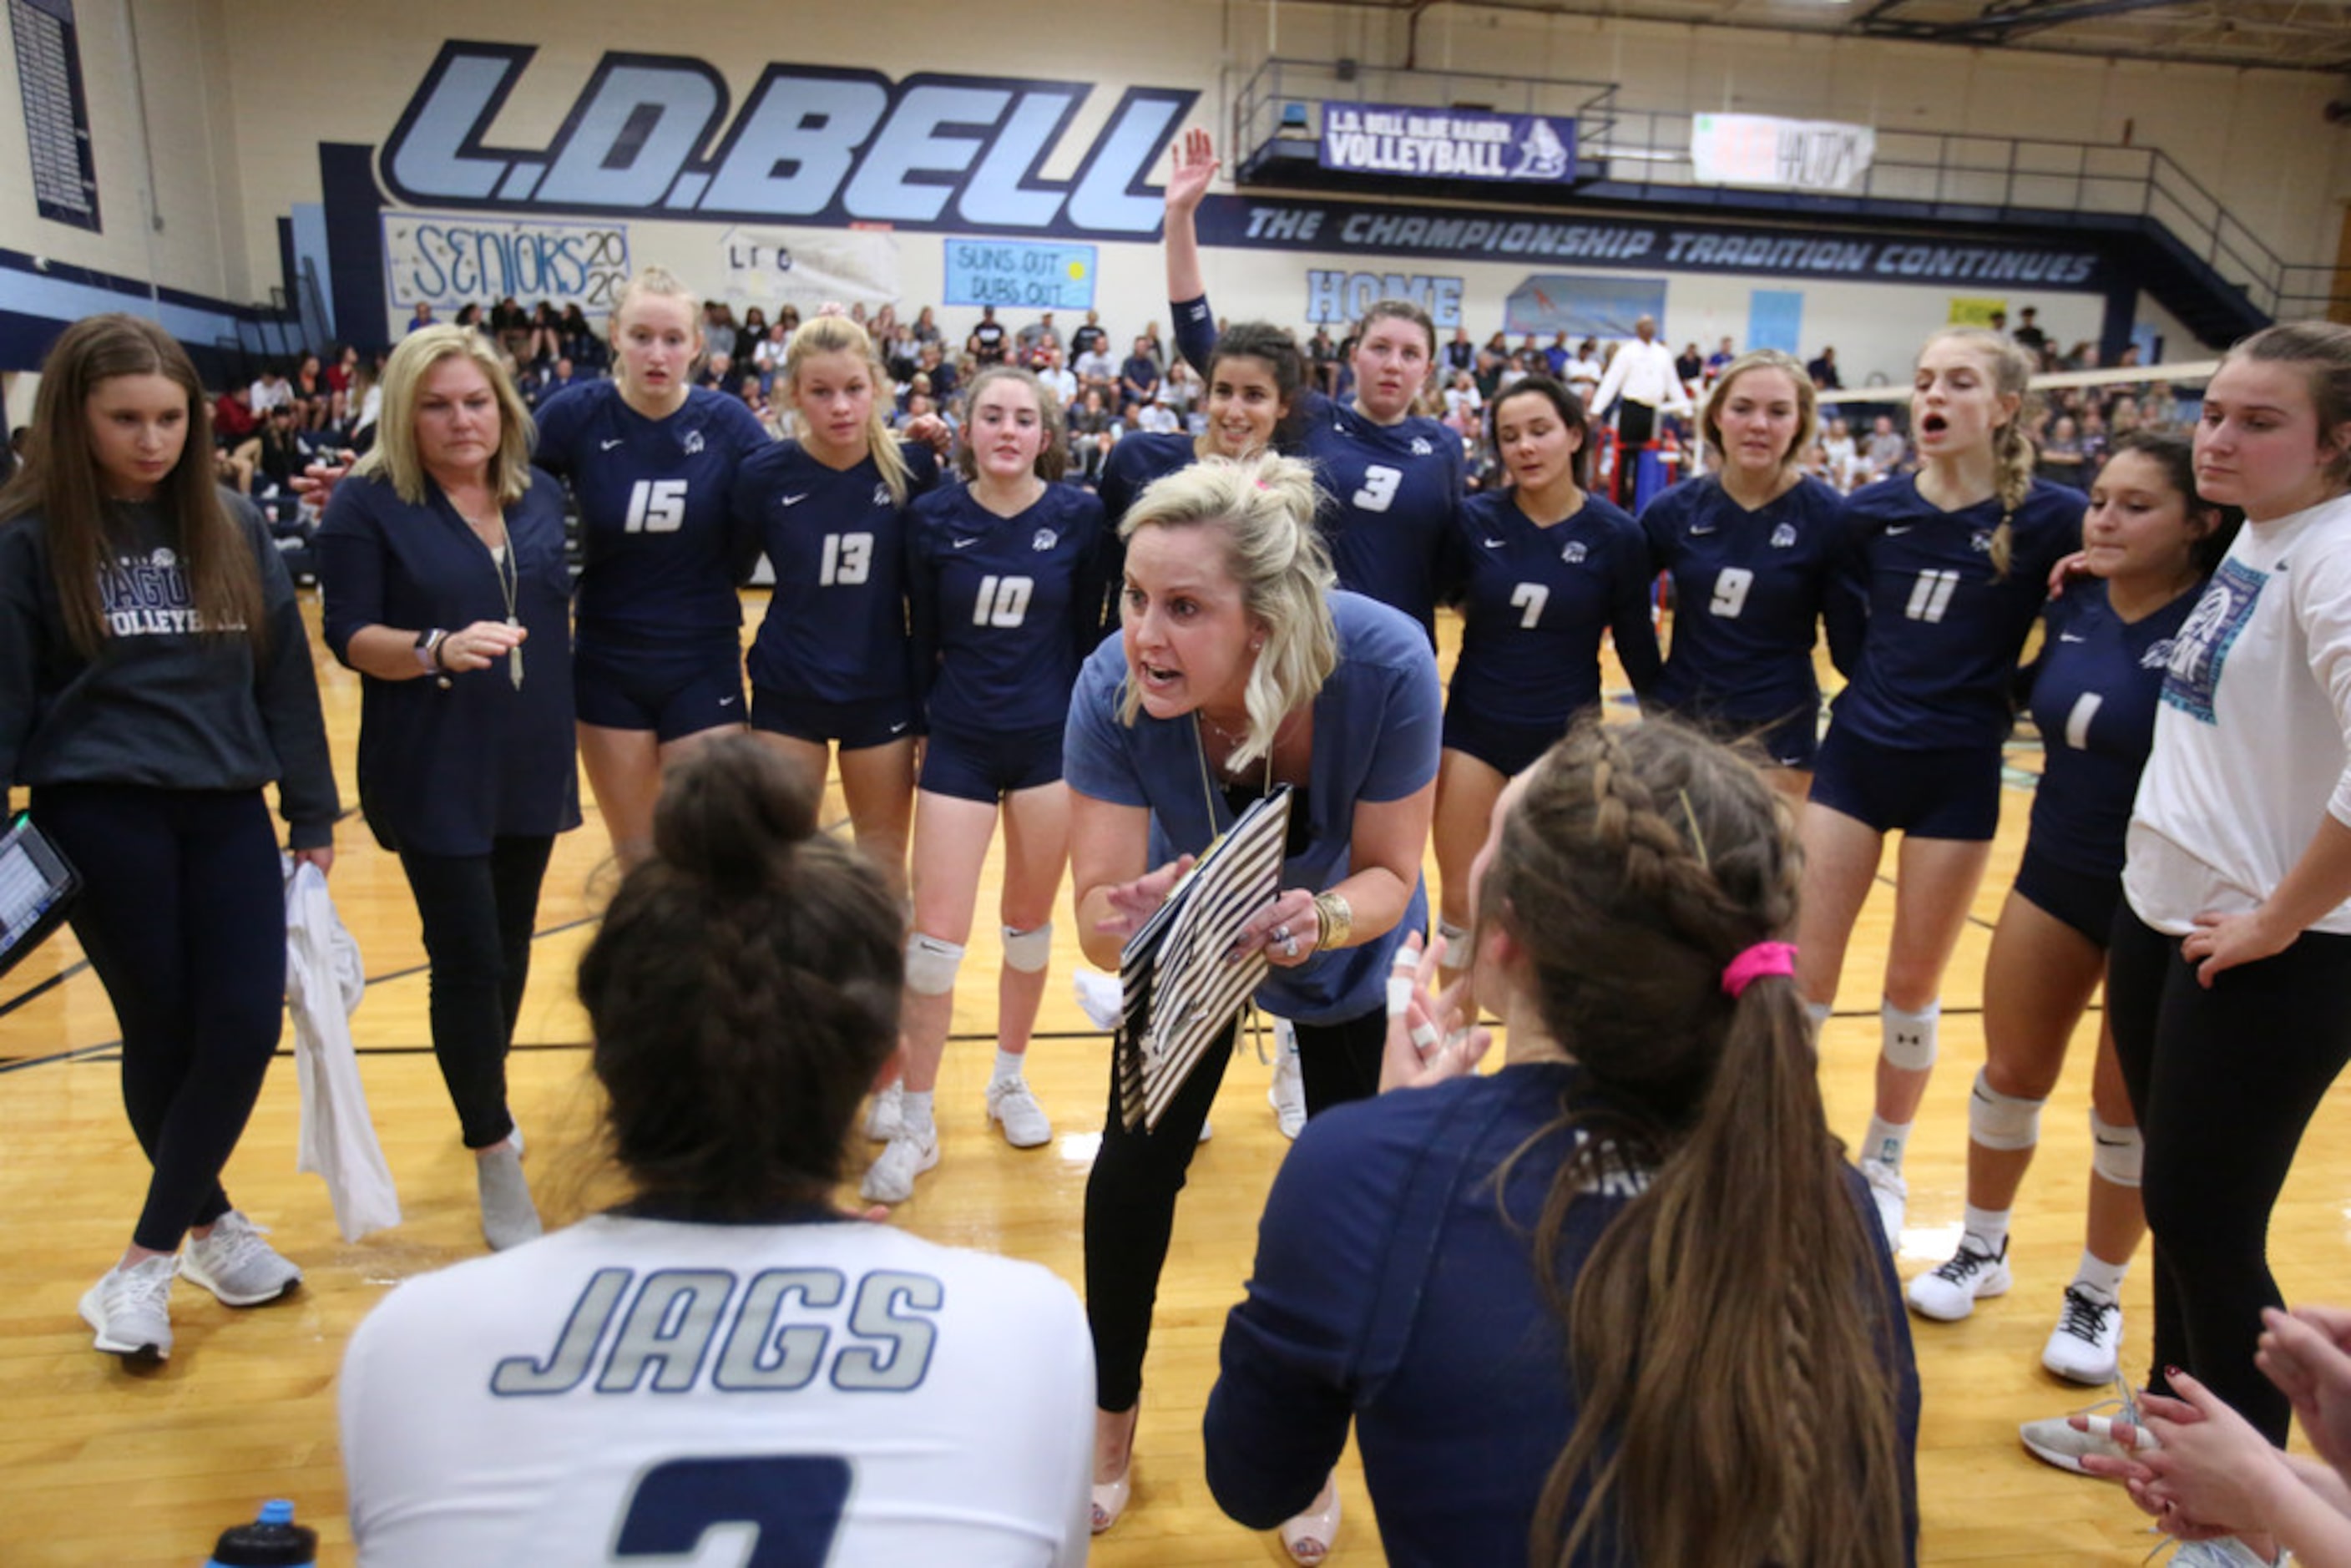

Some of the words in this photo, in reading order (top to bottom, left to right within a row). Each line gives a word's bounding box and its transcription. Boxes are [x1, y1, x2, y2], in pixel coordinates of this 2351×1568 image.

[1327, 132, 1507, 176] VOLLEYBALL
[413, 224, 587, 298] SENIORS
[585, 230, 626, 268] 20
[1022, 250, 1061, 276] OUT
[1245, 207, 1324, 240] THE
[1341, 214, 1655, 259] CHAMPIONSHIP
[1666, 233, 1870, 271] TRADITION
[1875, 245, 2096, 283] CONTINUES
[971, 276, 1020, 304] DUBS
[1026, 281, 1063, 306] OUT
[1306, 269, 1464, 329] HOME
[624, 478, 689, 534] 15
[1352, 464, 1403, 513] 3
[819, 532, 874, 587] 13
[972, 574, 1034, 628] 10
[1509, 582, 1551, 630] 7
[1708, 566, 1755, 620] 9
[1904, 569, 1961, 624] 11
[2065, 690, 2103, 751] 1
[488, 1266, 945, 1398] JAGS
